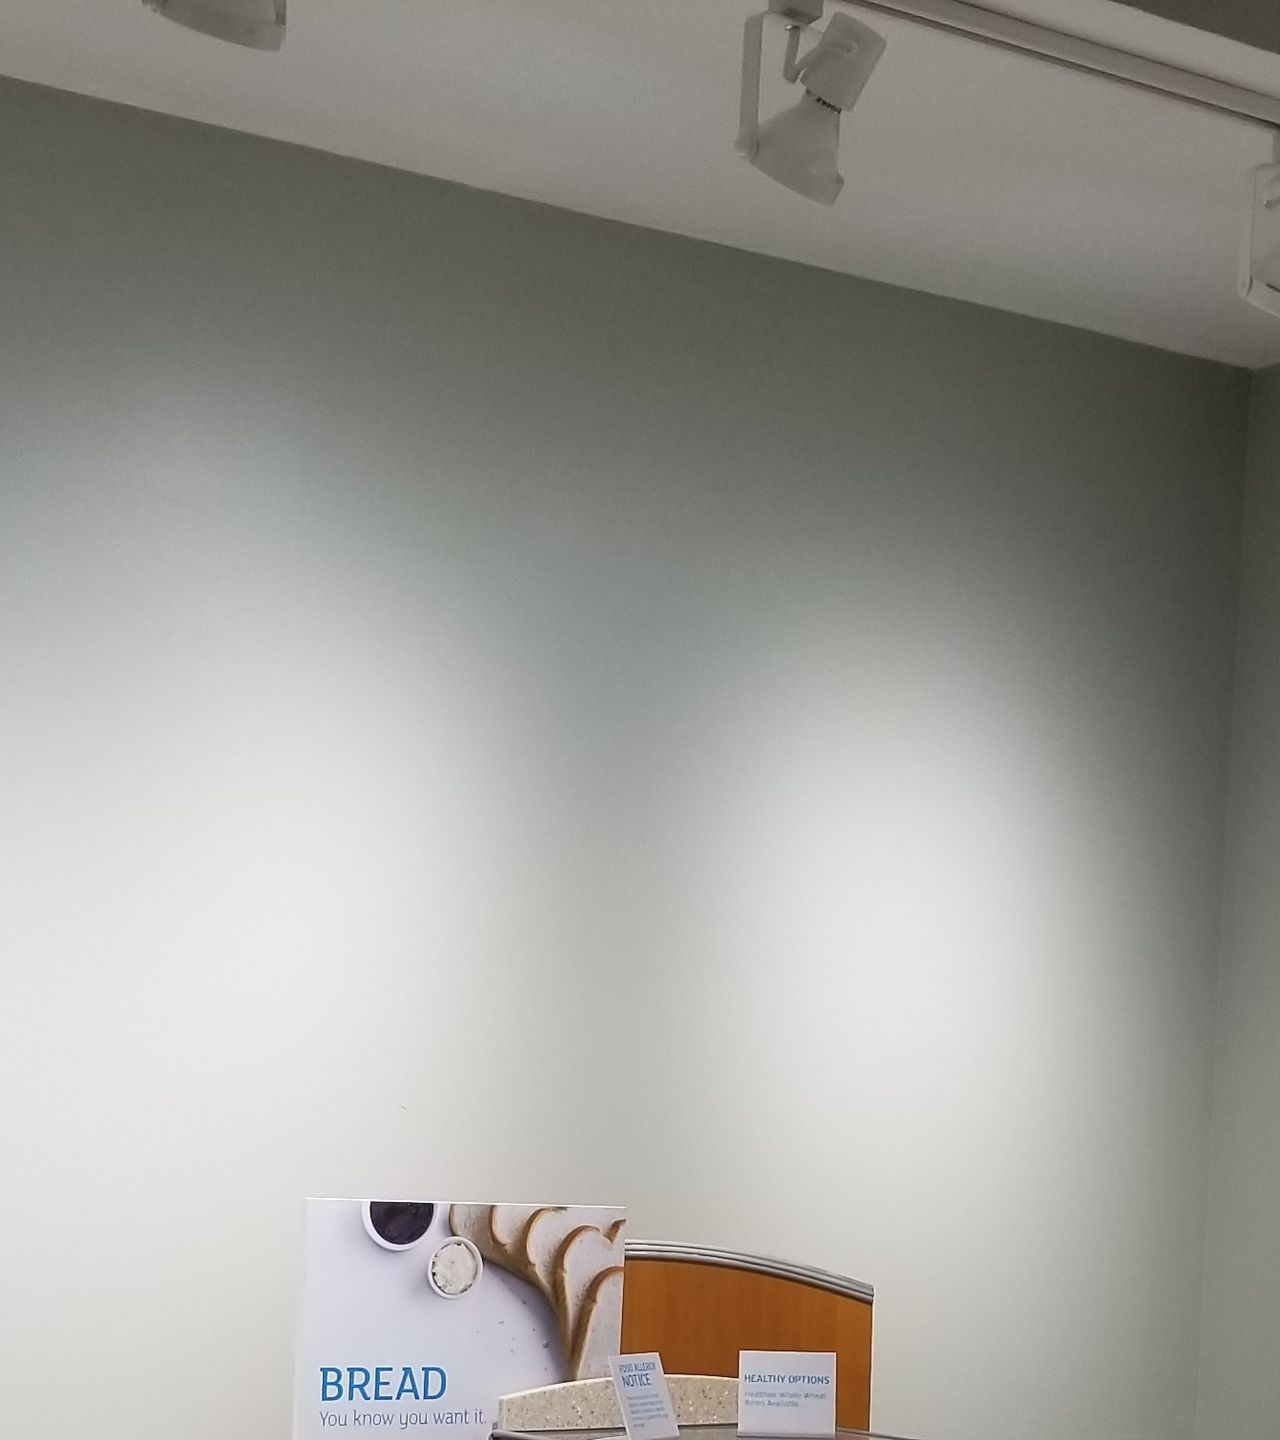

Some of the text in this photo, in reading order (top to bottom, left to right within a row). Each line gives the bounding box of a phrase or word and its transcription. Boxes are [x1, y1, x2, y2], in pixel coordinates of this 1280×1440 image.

[619, 1363, 634, 1374] FOOD
[319, 1366, 448, 1402] BREAD
[621, 1372, 653, 1388] NOTICE
[744, 1373, 830, 1386] HEALTHY OPTIONS
[319, 1408, 488, 1430] You know you want it.
